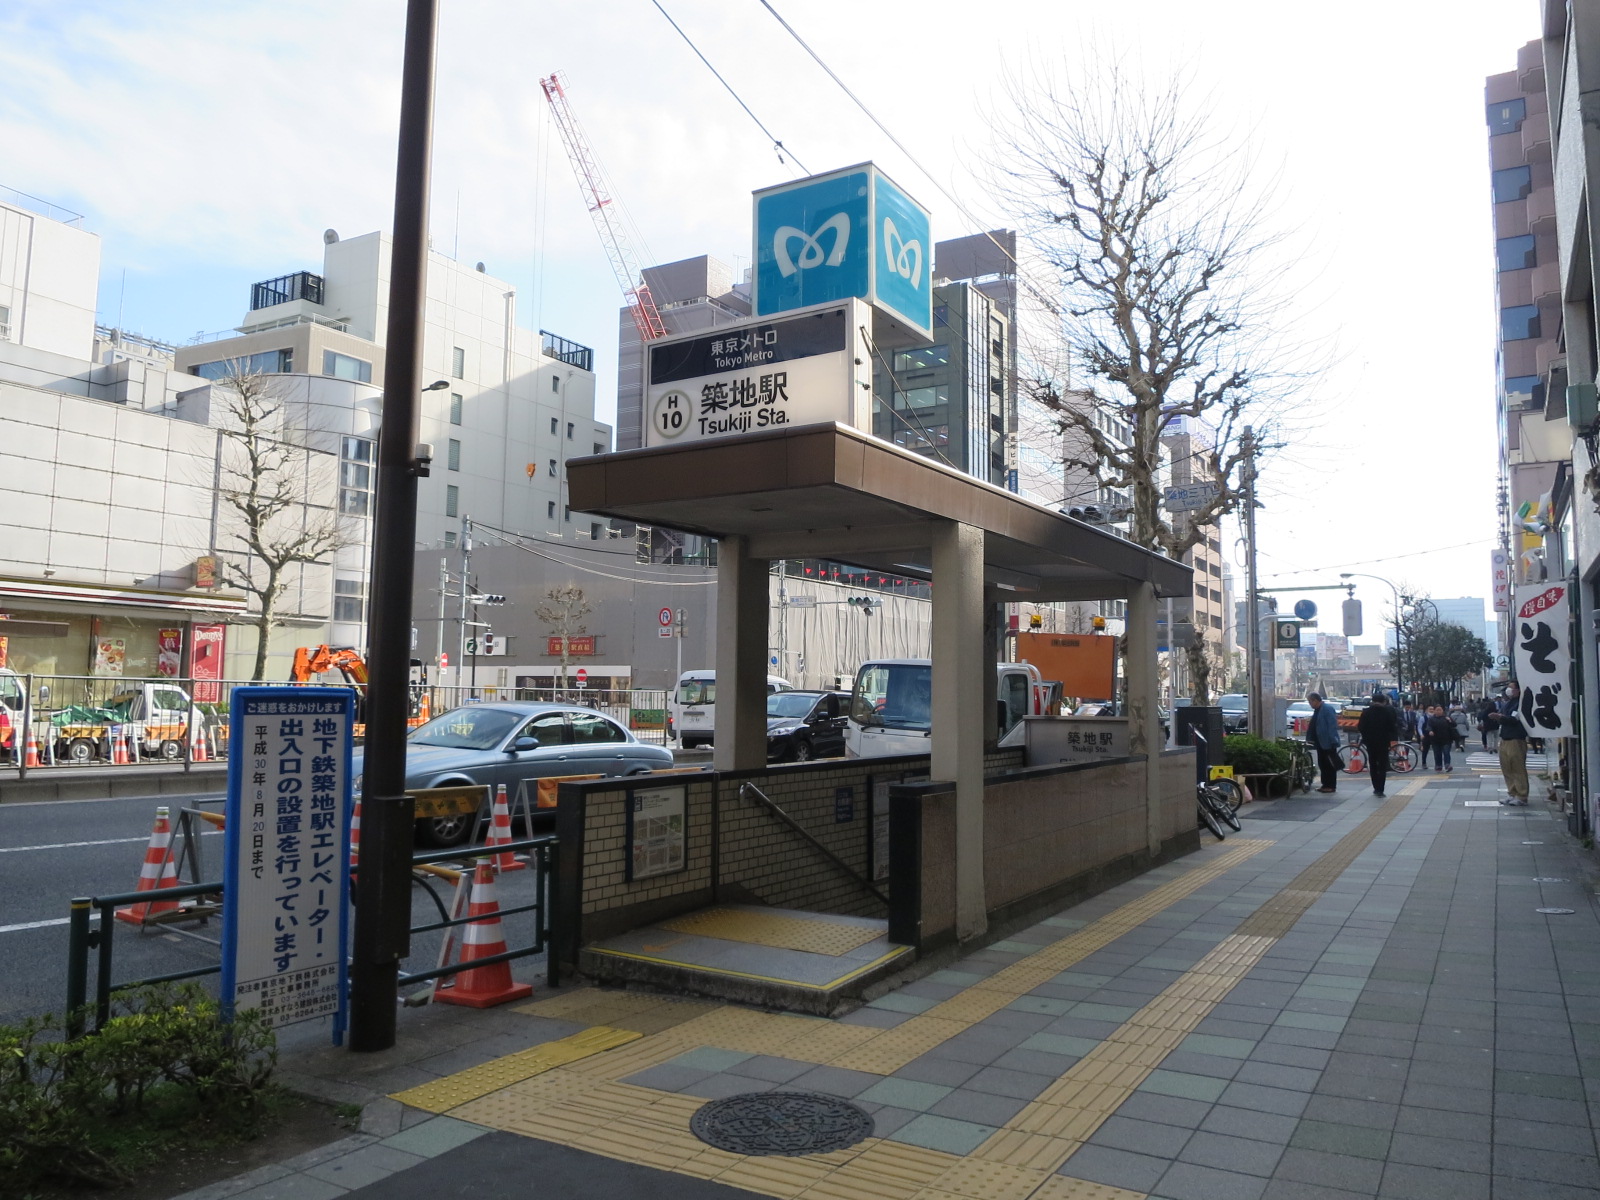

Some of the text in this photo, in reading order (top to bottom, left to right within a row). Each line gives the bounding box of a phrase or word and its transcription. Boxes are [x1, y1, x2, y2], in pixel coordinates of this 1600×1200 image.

[711, 330, 777, 356] 東京メトロ
[715, 350, 773, 369] Tokyo Metro
[668, 395, 678, 409] H
[701, 371, 788, 415] 築地駅
[661, 411, 683, 430] 10
[698, 408, 790, 435] Tsukiji Sta.
[1521, 621, 1562, 730] そば
[247, 702, 342, 714] ご迷惑をおかけします
[1067, 732, 1113, 746] 築地駅
[273, 718, 304, 972] 出入口の設置を行っています
